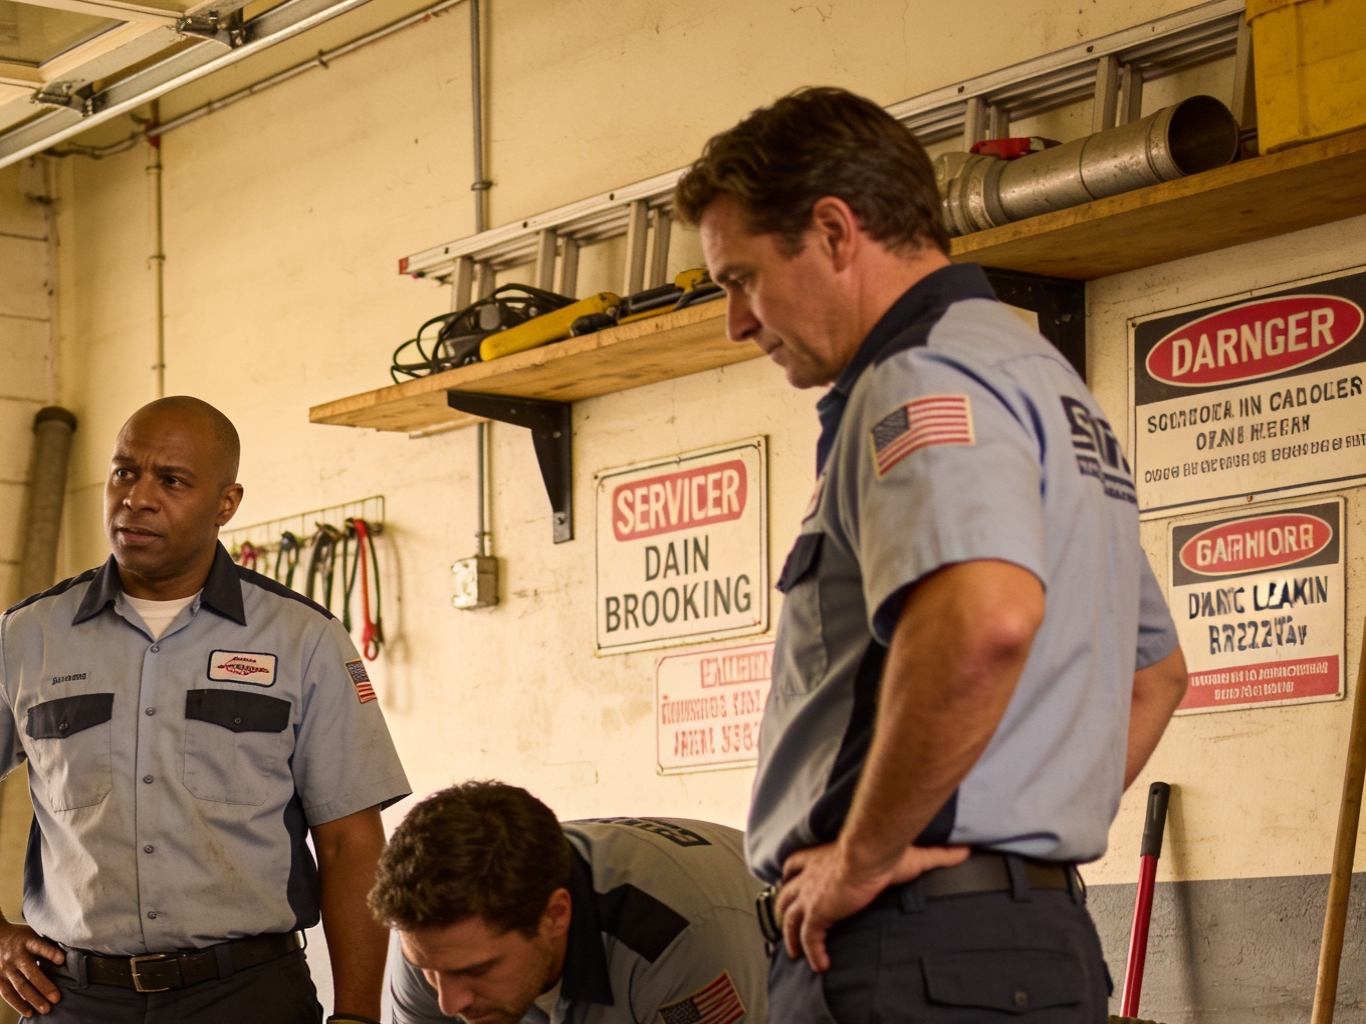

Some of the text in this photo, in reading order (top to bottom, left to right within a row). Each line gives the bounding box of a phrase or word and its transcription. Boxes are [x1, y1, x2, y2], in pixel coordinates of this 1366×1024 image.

[1171, 307, 1335, 378] DARNGER
[616, 468, 741, 535] SERVICER
[644, 534, 709, 582] DAIN
[605, 574, 752, 633] BROOKING
